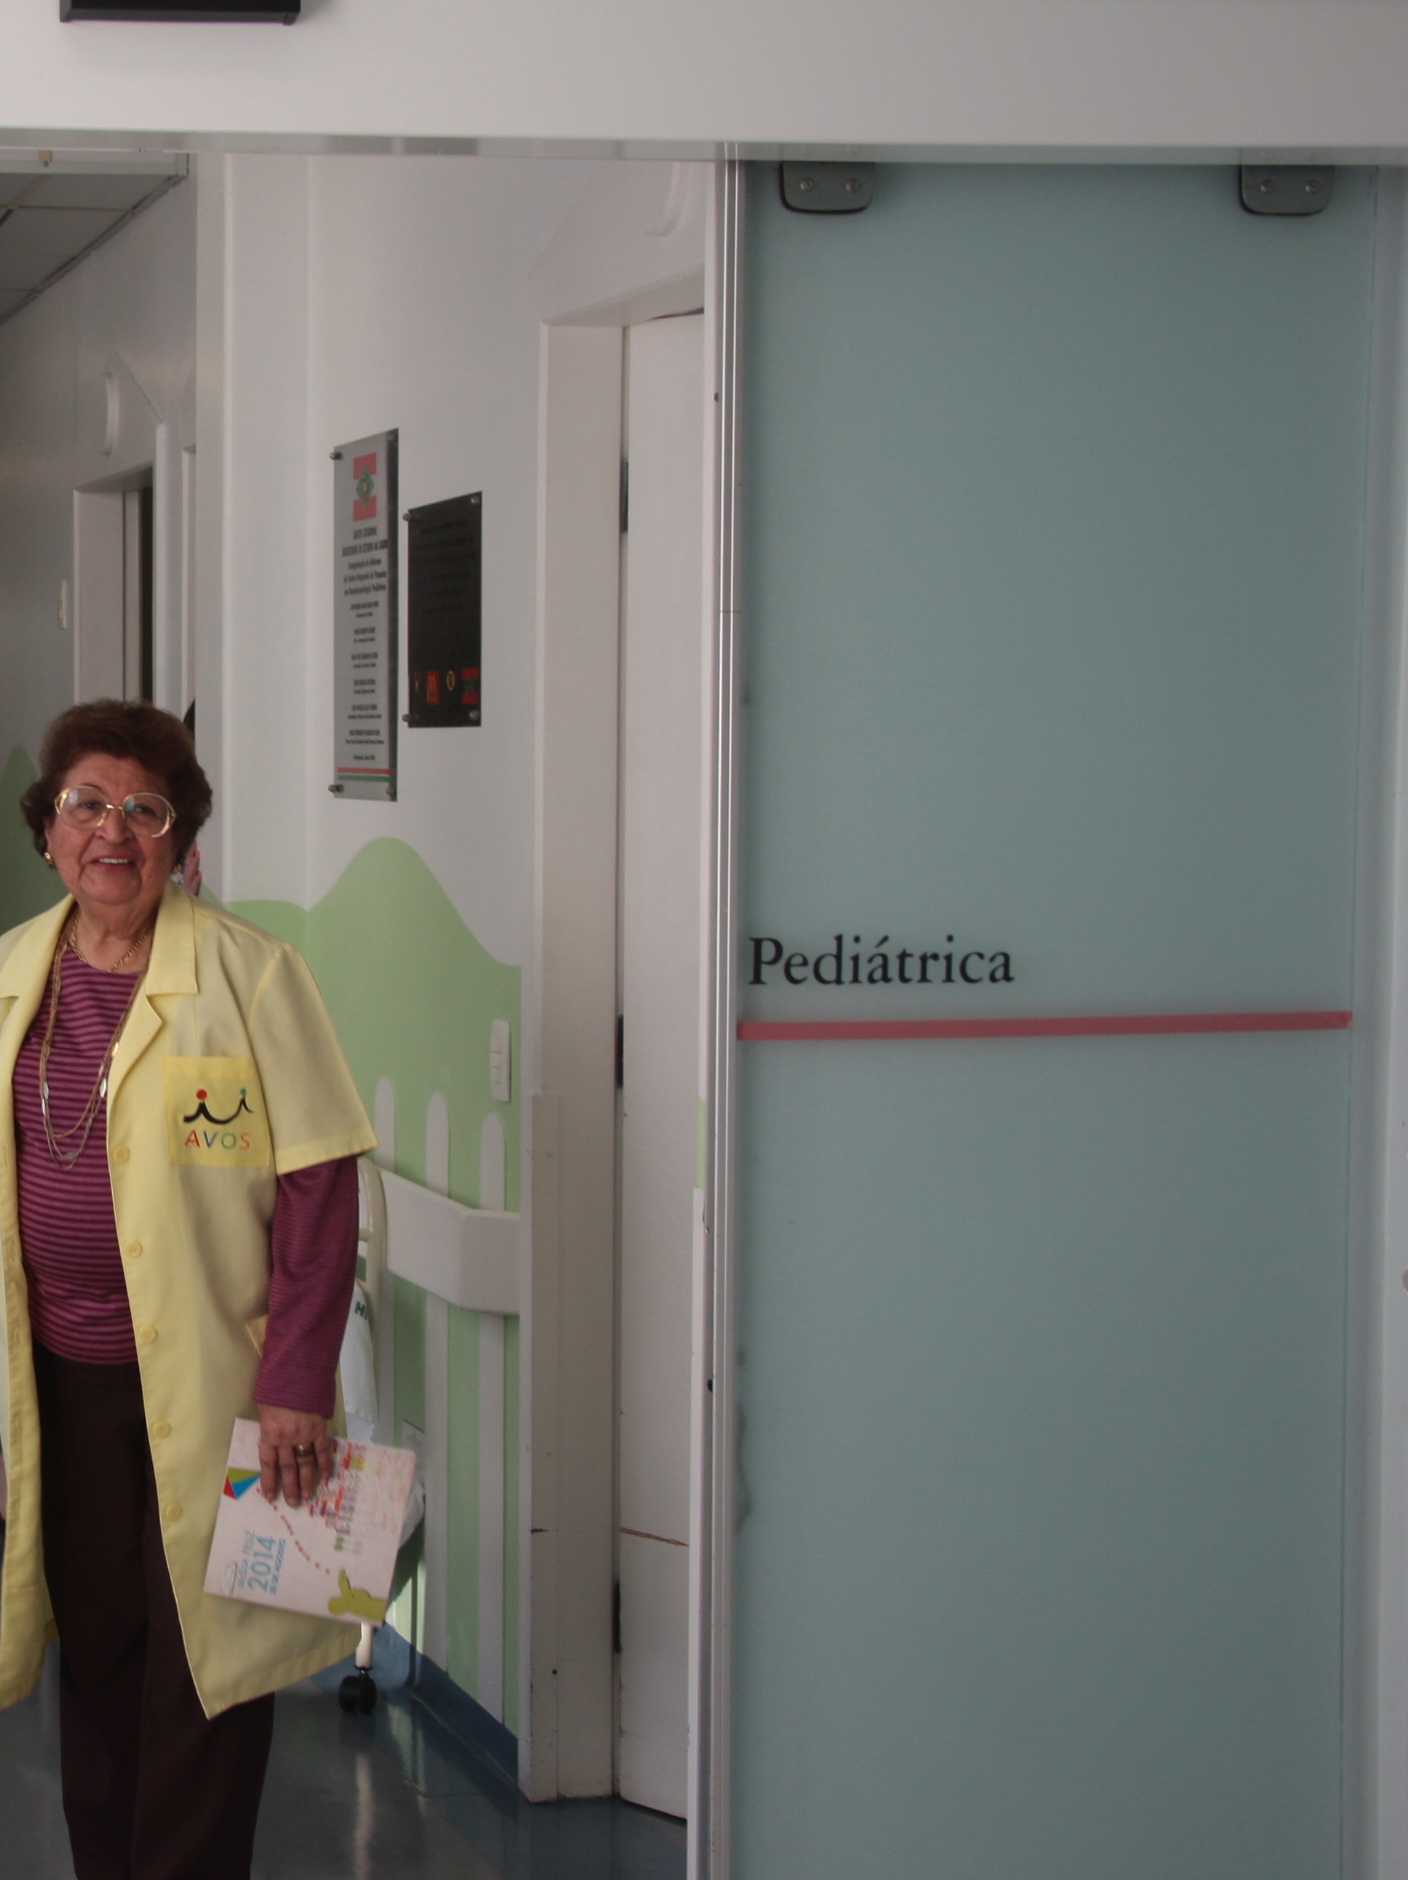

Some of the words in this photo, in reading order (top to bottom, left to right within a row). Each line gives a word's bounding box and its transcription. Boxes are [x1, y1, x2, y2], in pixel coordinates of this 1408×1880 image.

[747, 933, 1015, 986] Pediátrica
[183, 1128, 251, 1151] AVOS
[247, 1536, 277, 1592] 2014
